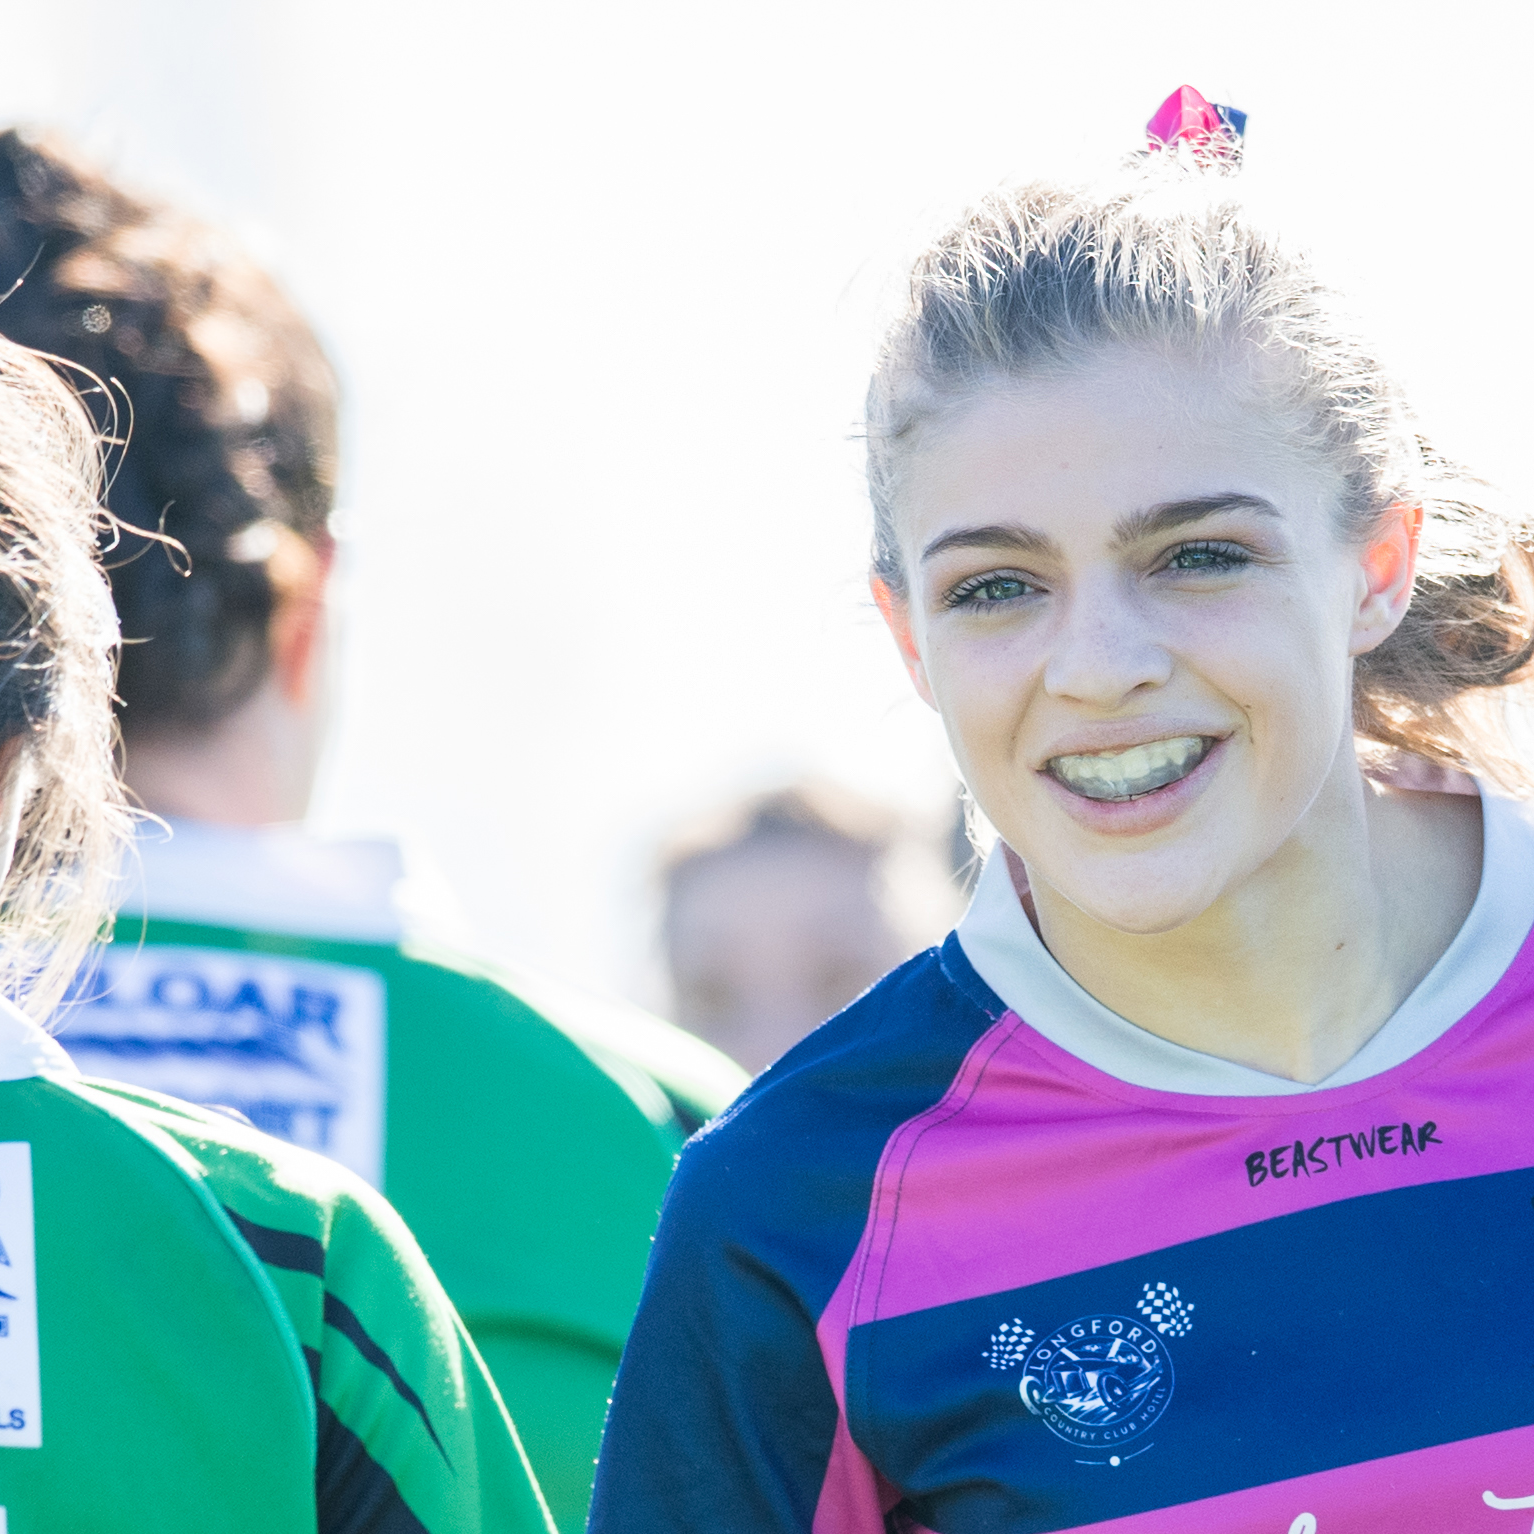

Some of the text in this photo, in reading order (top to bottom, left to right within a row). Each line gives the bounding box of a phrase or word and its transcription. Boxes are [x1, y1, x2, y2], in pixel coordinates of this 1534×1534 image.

[1245, 1121, 1443, 1188] BEASTWEAR
[1029, 1319, 1157, 1371] LONGFORD
[1044, 1407, 1097, 1441] COUNTRY
[1103, 1422, 1137, 1440] CLUB
